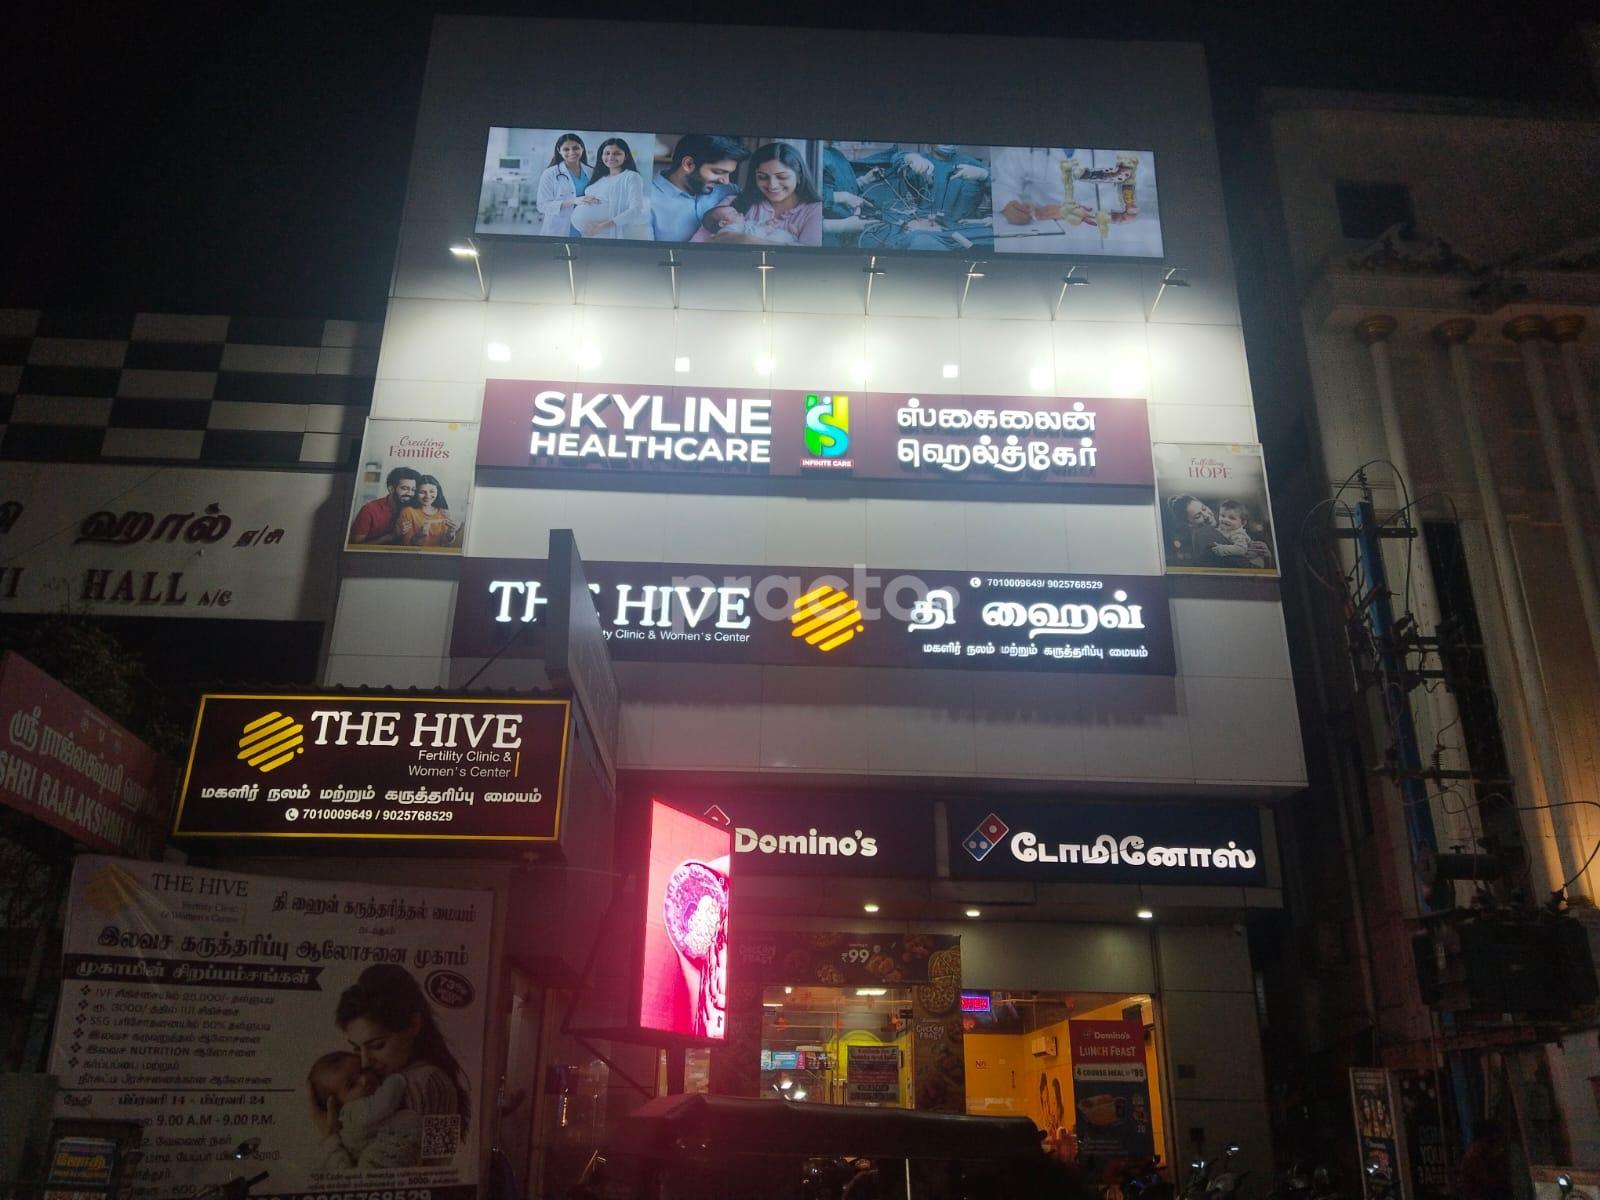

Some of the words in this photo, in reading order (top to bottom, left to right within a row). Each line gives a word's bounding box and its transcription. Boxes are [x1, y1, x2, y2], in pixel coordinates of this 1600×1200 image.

[531, 390, 772, 434] SKYLINE
[897, 398, 1096, 431] ஸ்கைலைன்
[389, 446, 450, 459] Families
[399, 436, 445, 449] Creating
[529, 431, 771, 463] HEALTHCARE
[897, 435, 1097, 472] ஹெல்த்கேர்
[801, 459, 831, 467] INFINITE
[832, 460, 852, 468] CARE
[1188, 466, 1232, 479] HOPE
[72, 502, 232, 545] ஹால்
[79, 567, 188, 606] HALL
[198, 590, 233, 607] A/C
[1047, 579, 1103, 590] 9025768529
[613, 584, 751, 629] HIVE
[907, 589, 957, 633] தி
[982, 590, 1146, 639] ஹைவ்
[615, 629, 646, 640] Clinic
[648, 630, 656, 640] &
[713, 632, 751, 643] Center
[923, 641, 961, 656] மகளிர்
[966, 642, 996, 656] நலம்
[1001, 643, 1038, 657] மற்றும்
[1043, 643, 1104, 659] கருத்தரிப்பு
[1109, 645, 1149, 659] மையம்
[311, 710, 400, 747] THE
[409, 713, 523, 750] HIVE
[418, 750, 463, 764] Fertility
[466, 751, 500, 763] Clinic
[503, 752, 512, 763] &
[470, 766, 511, 778] Center
[201, 784, 260, 800] மகளிர்
[267, 785, 311, 801] நலம்
[320, 785, 376, 803] மற்றும்
[385, 787, 475, 806] கருத்தரிப்பு
[484, 788, 542, 804] மையம்
[302, 809, 373, 821] 7010009649
[374, 810, 381, 821] /
[382, 810, 453, 822] 9025768529
[734, 827, 878, 857] Domino's
[1011, 831, 1256, 869] டோமினோஸ்
[152, 873, 194, 893] THE
[200, 878, 249, 897] HIVE
[97, 926, 174, 950] இலவச
[181, 931, 289, 961] கருத்தரிப்பு
[295, 939, 408, 963] ஆலோசனை
[414, 944, 469, 969] முகாம்
[76, 958, 166, 978] முகாமின்
[130, 1045, 190, 1057] NUTRITION
[157, 1114, 184, 1126] 9.00
[223, 1114, 249, 1126] 9.00
